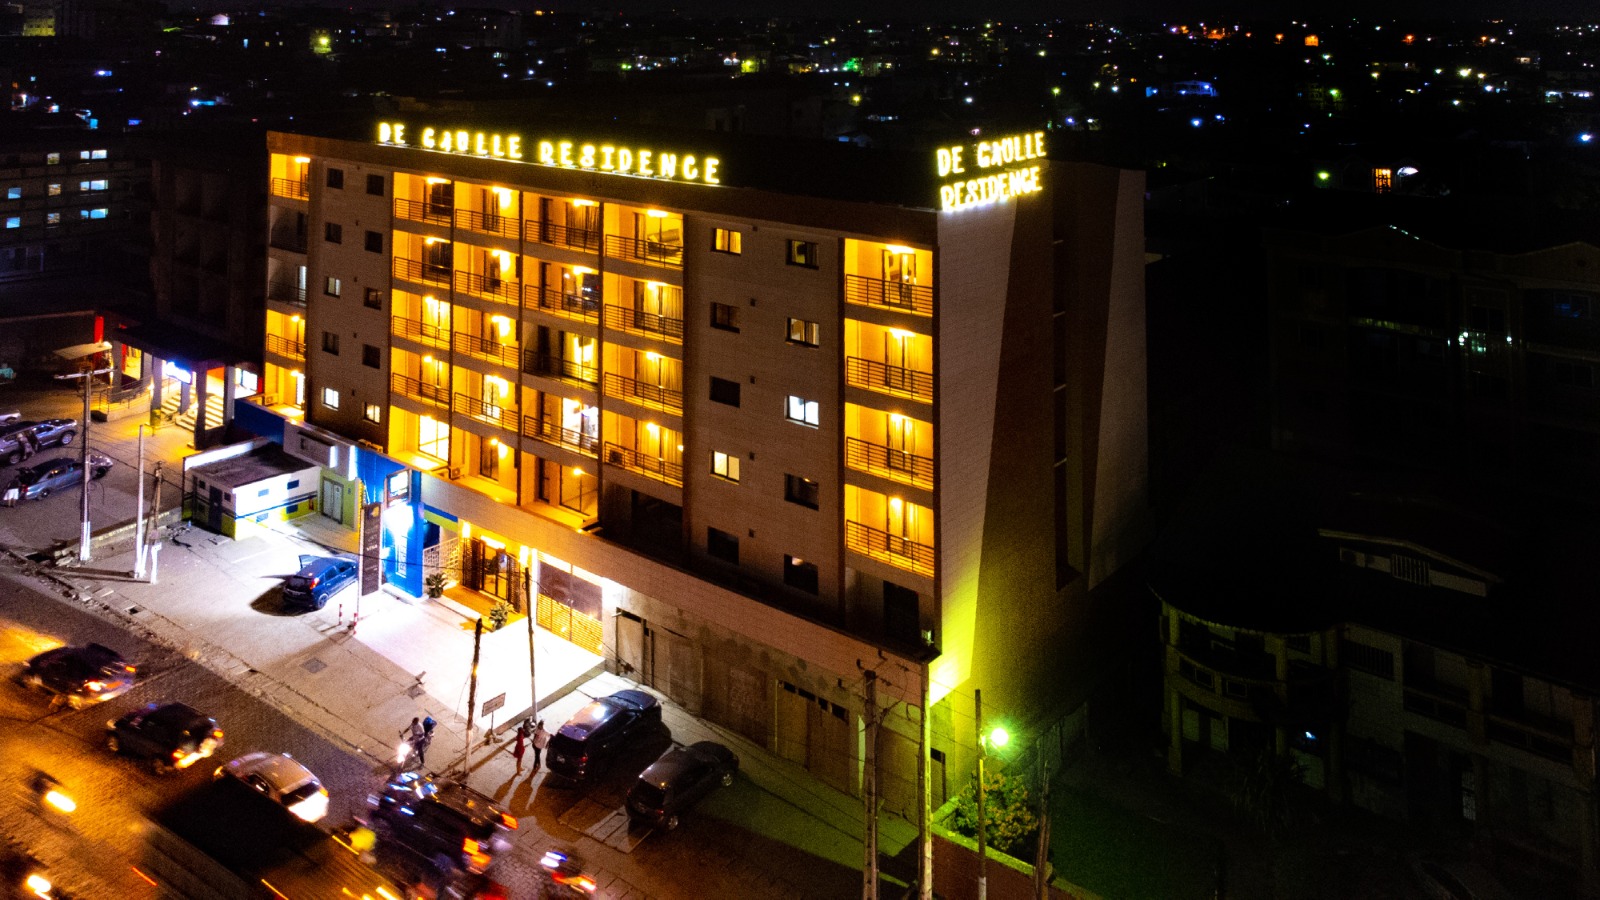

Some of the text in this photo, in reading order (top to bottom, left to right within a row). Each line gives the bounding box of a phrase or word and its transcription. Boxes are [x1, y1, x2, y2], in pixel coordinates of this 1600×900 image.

[378, 122, 720, 184] DE GAULLE RESIDENCE
[937, 132, 1046, 177] DE GAULLE
[940, 166, 1043, 213] RESIDENCE
